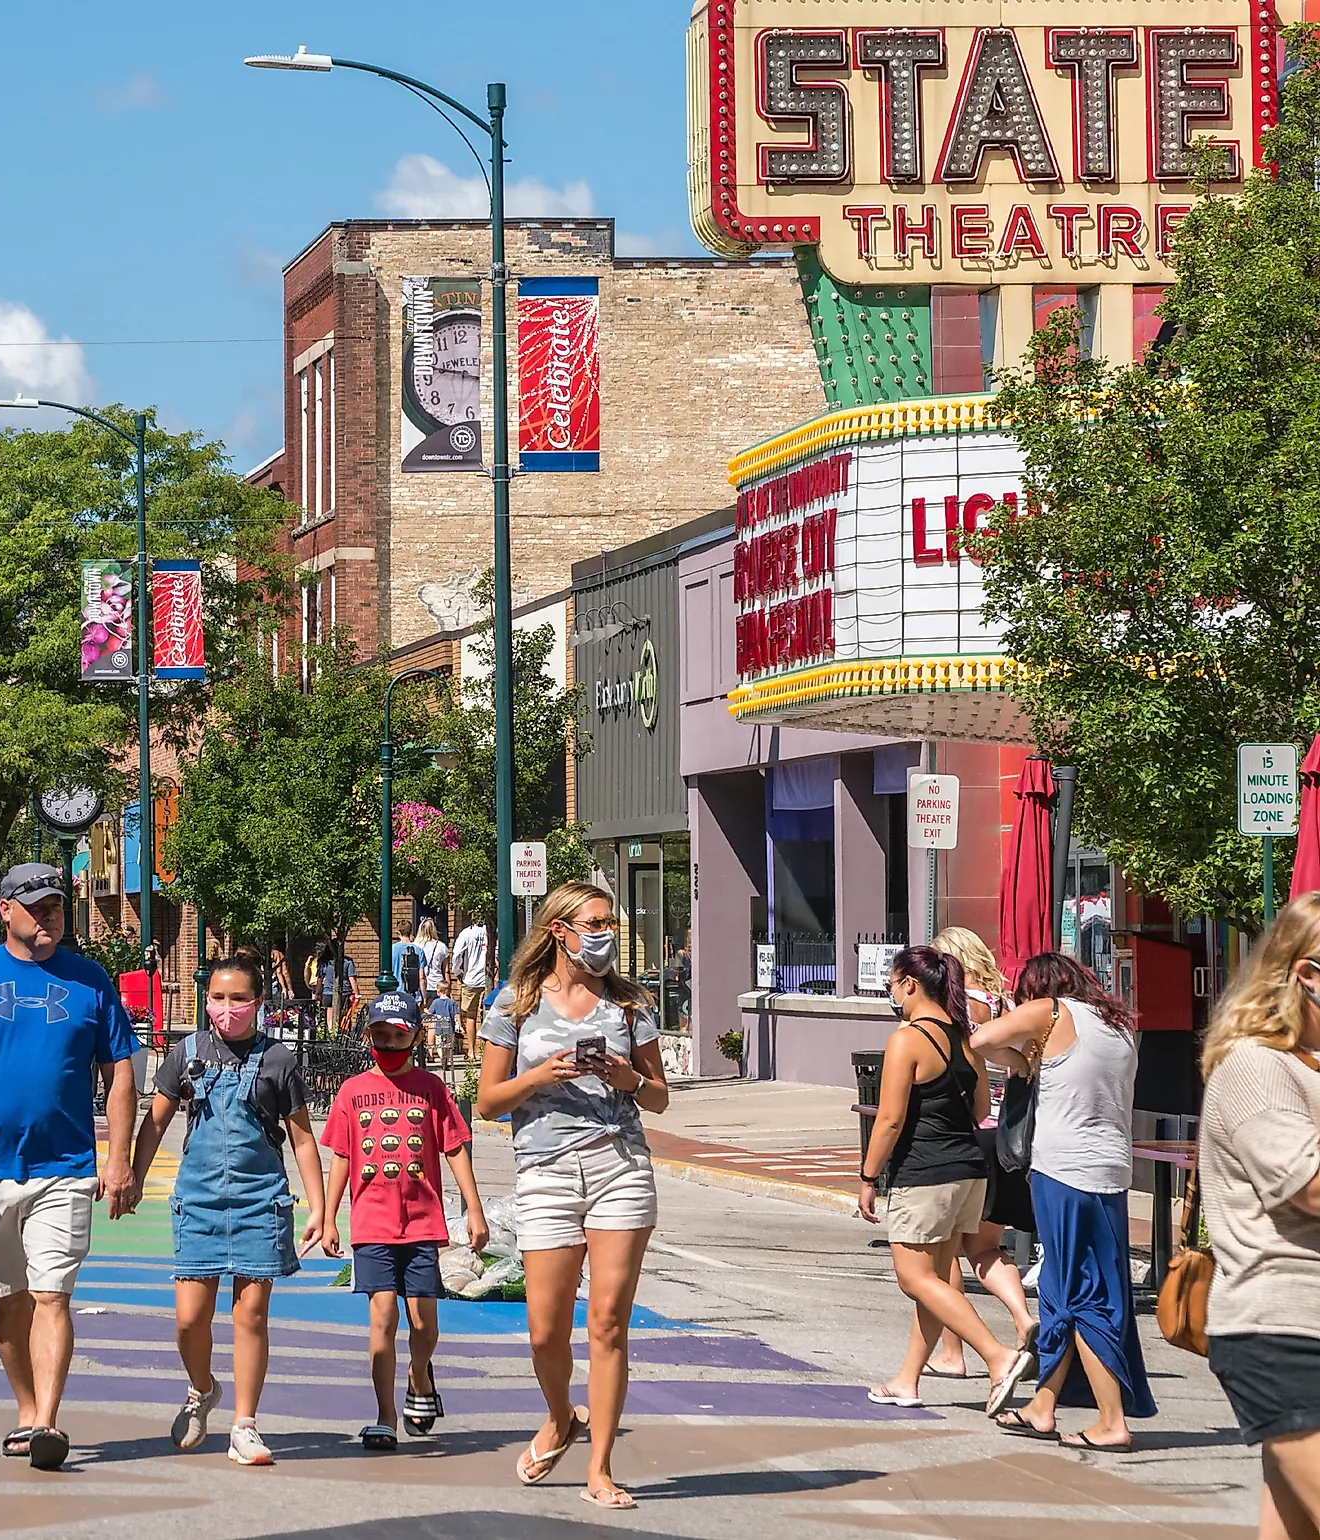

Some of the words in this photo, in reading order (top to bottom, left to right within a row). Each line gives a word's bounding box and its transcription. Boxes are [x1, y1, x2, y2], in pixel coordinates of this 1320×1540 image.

[755, 26, 1243, 185] STATE
[413, 290, 434, 375] DOWNTOWN
[453, 330, 468, 345] 12
[439, 357, 480, 373] JEWELE
[546, 300, 572, 449] Celebrate!
[457, 434, 470, 444] TC
[88, 568, 101, 621] DOWNTOWN
[168, 573, 187, 666] Celebrate!
[1262, 757, 1274, 768] 15
[1247, 775, 1289, 786] MINUTE
[928, 785, 940, 794] NO
[916, 799, 951, 810] PARKING
[1243, 792, 1293, 805] LOADING
[916, 814, 952, 824] THEATER
[1253, 811, 1284, 822] ZONE
[924, 828, 942, 838] EXIT
[352, 1092, 384, 1110] MOODS
[398, 1091, 430, 1104] NINJA
